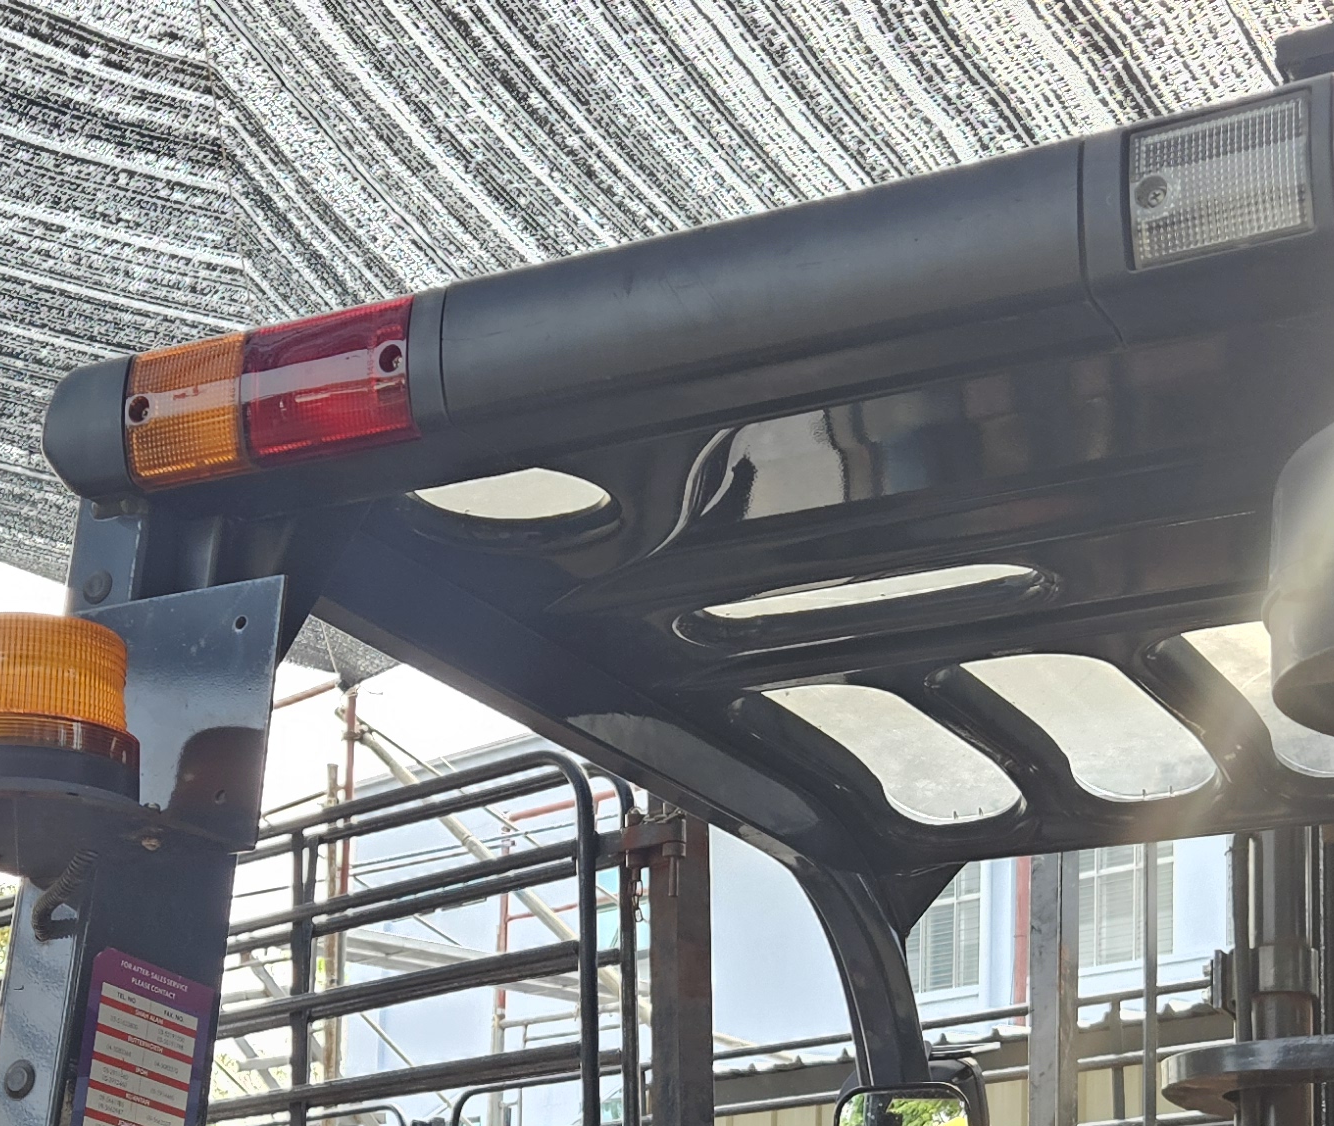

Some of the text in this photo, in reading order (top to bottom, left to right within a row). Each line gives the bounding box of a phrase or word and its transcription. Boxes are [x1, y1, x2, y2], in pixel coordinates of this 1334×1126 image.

[131, 977, 176, 999] PLEASE CONTACT
[167, 979, 188, 991] SERVICE
